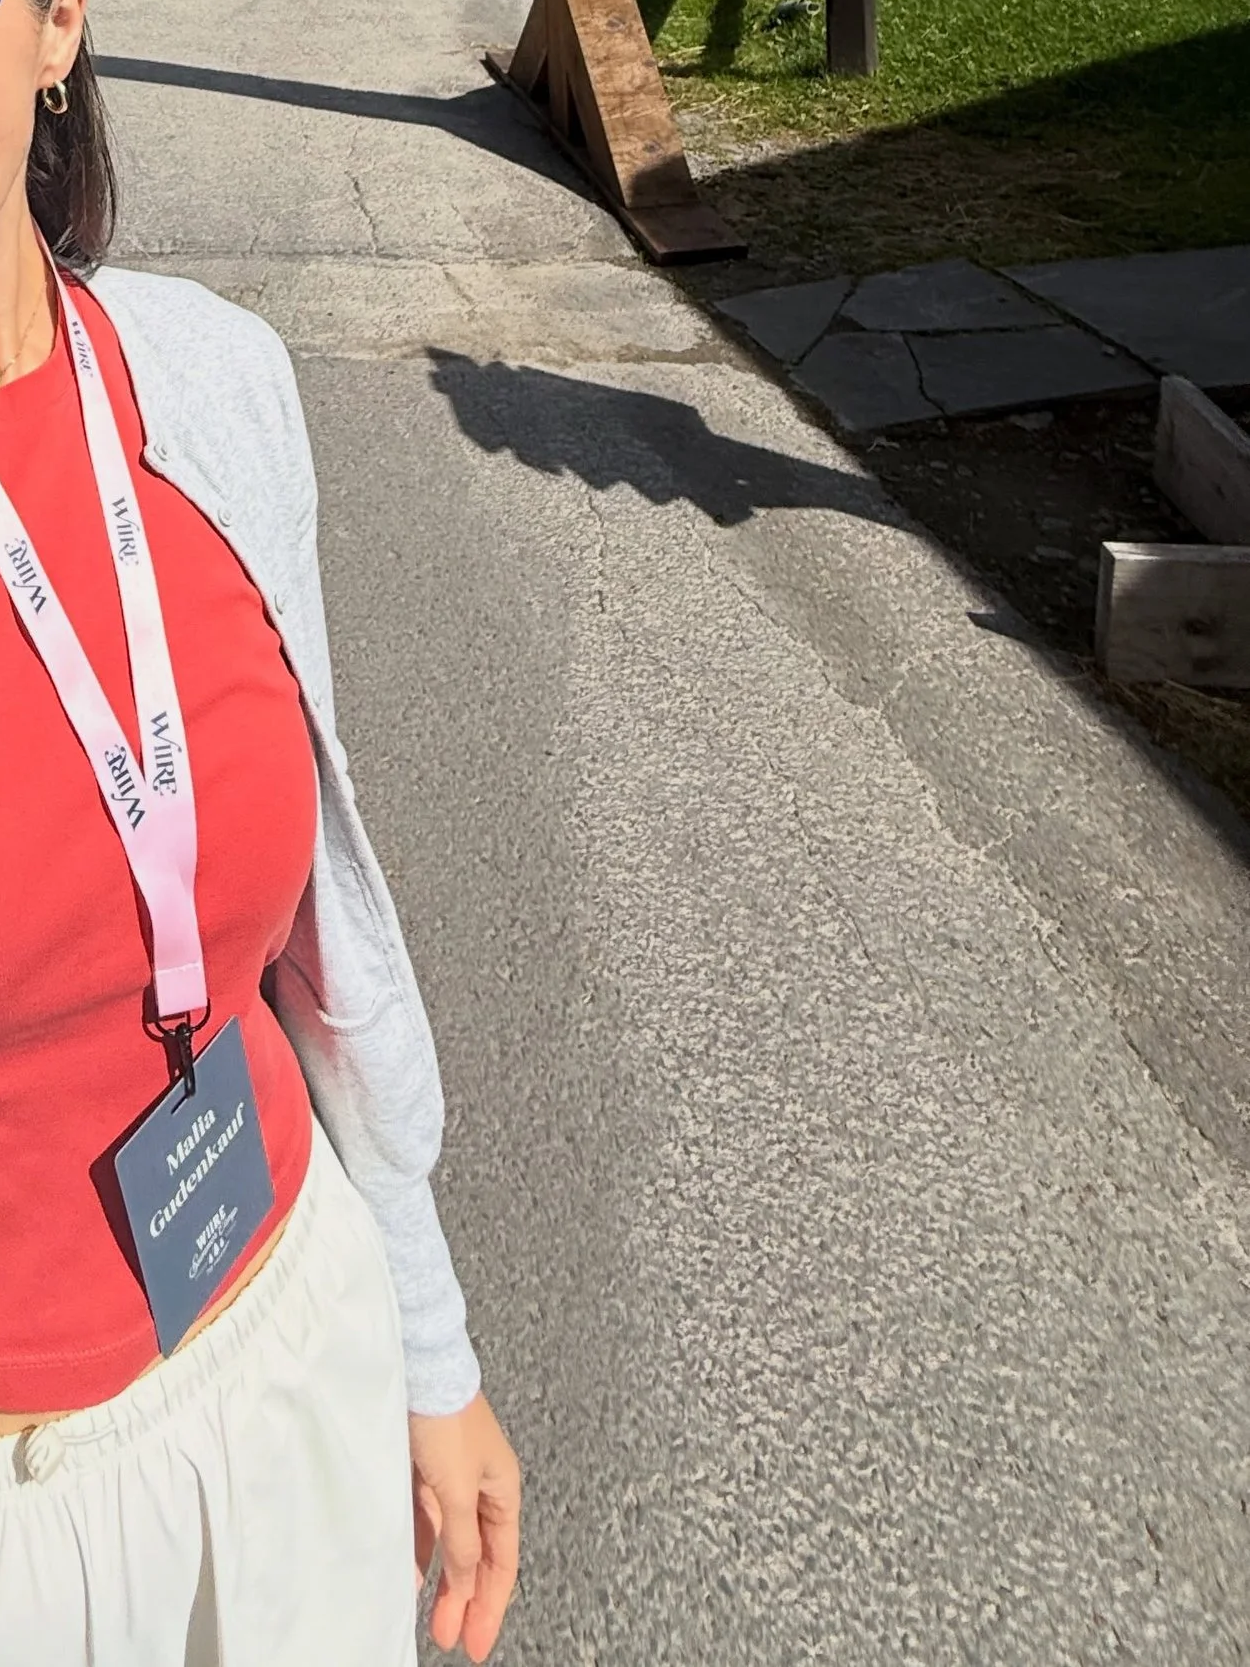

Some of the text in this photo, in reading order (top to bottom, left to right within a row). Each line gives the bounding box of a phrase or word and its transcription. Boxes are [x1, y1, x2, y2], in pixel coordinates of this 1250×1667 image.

[111, 496, 141, 567] WIIRE
[3, 537, 48, 616] WIIRE
[104, 743, 147, 833] WIIRE
[150, 710, 183, 797] WIIRE
[149, 1101, 245, 1239] Gudenkauf
[165, 1109, 217, 1177] Malia
